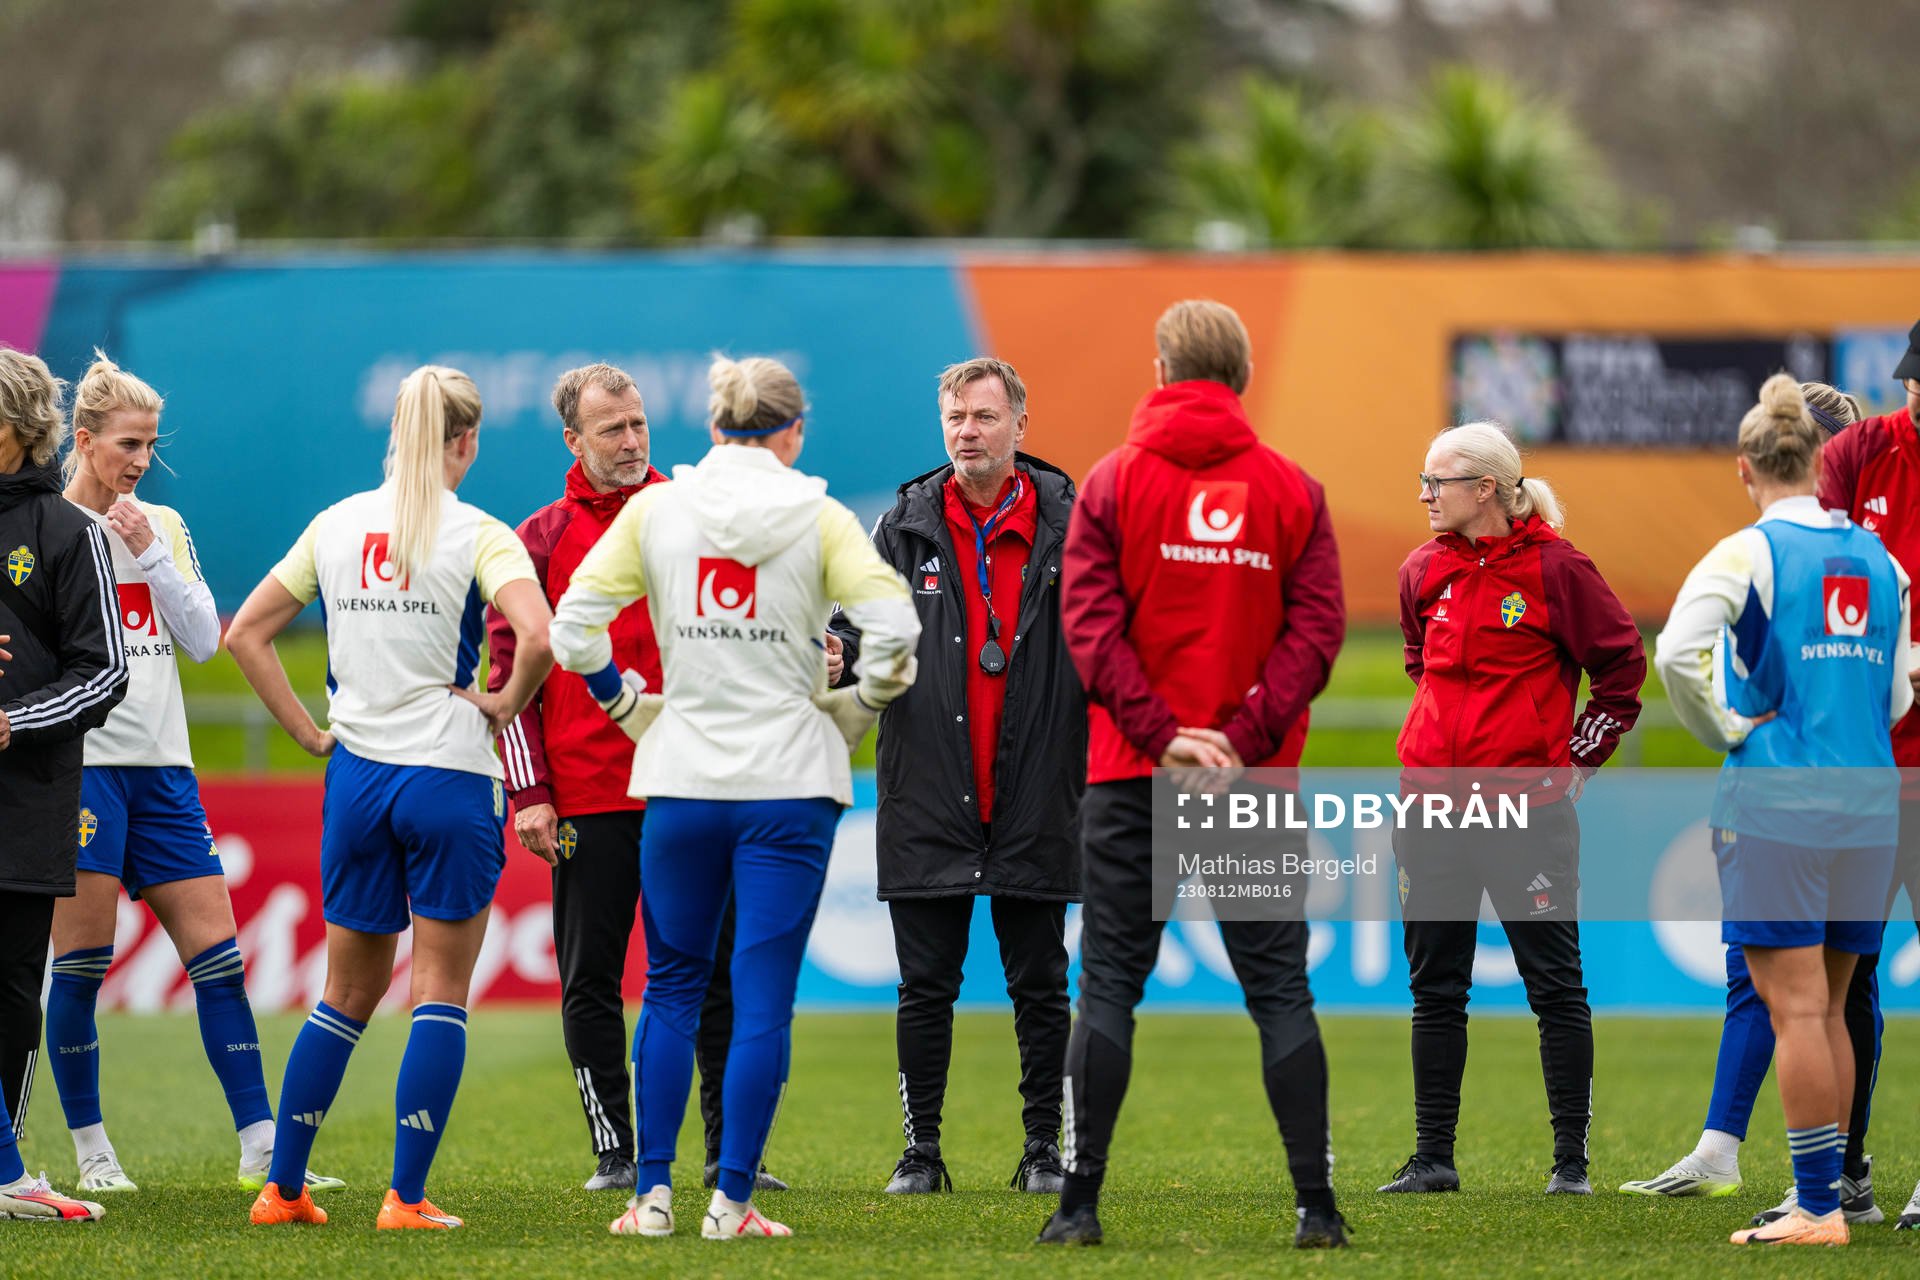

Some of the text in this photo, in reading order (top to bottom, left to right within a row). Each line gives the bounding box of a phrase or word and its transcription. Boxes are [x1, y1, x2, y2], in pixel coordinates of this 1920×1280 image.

[1160, 543, 1272, 571] VENSKA SPEL
[337, 598, 440, 615] SVENSKA SPEL
[676, 625, 789, 642] VENSKA SPEL
[1801, 643, 1864, 661] SVENSKA
